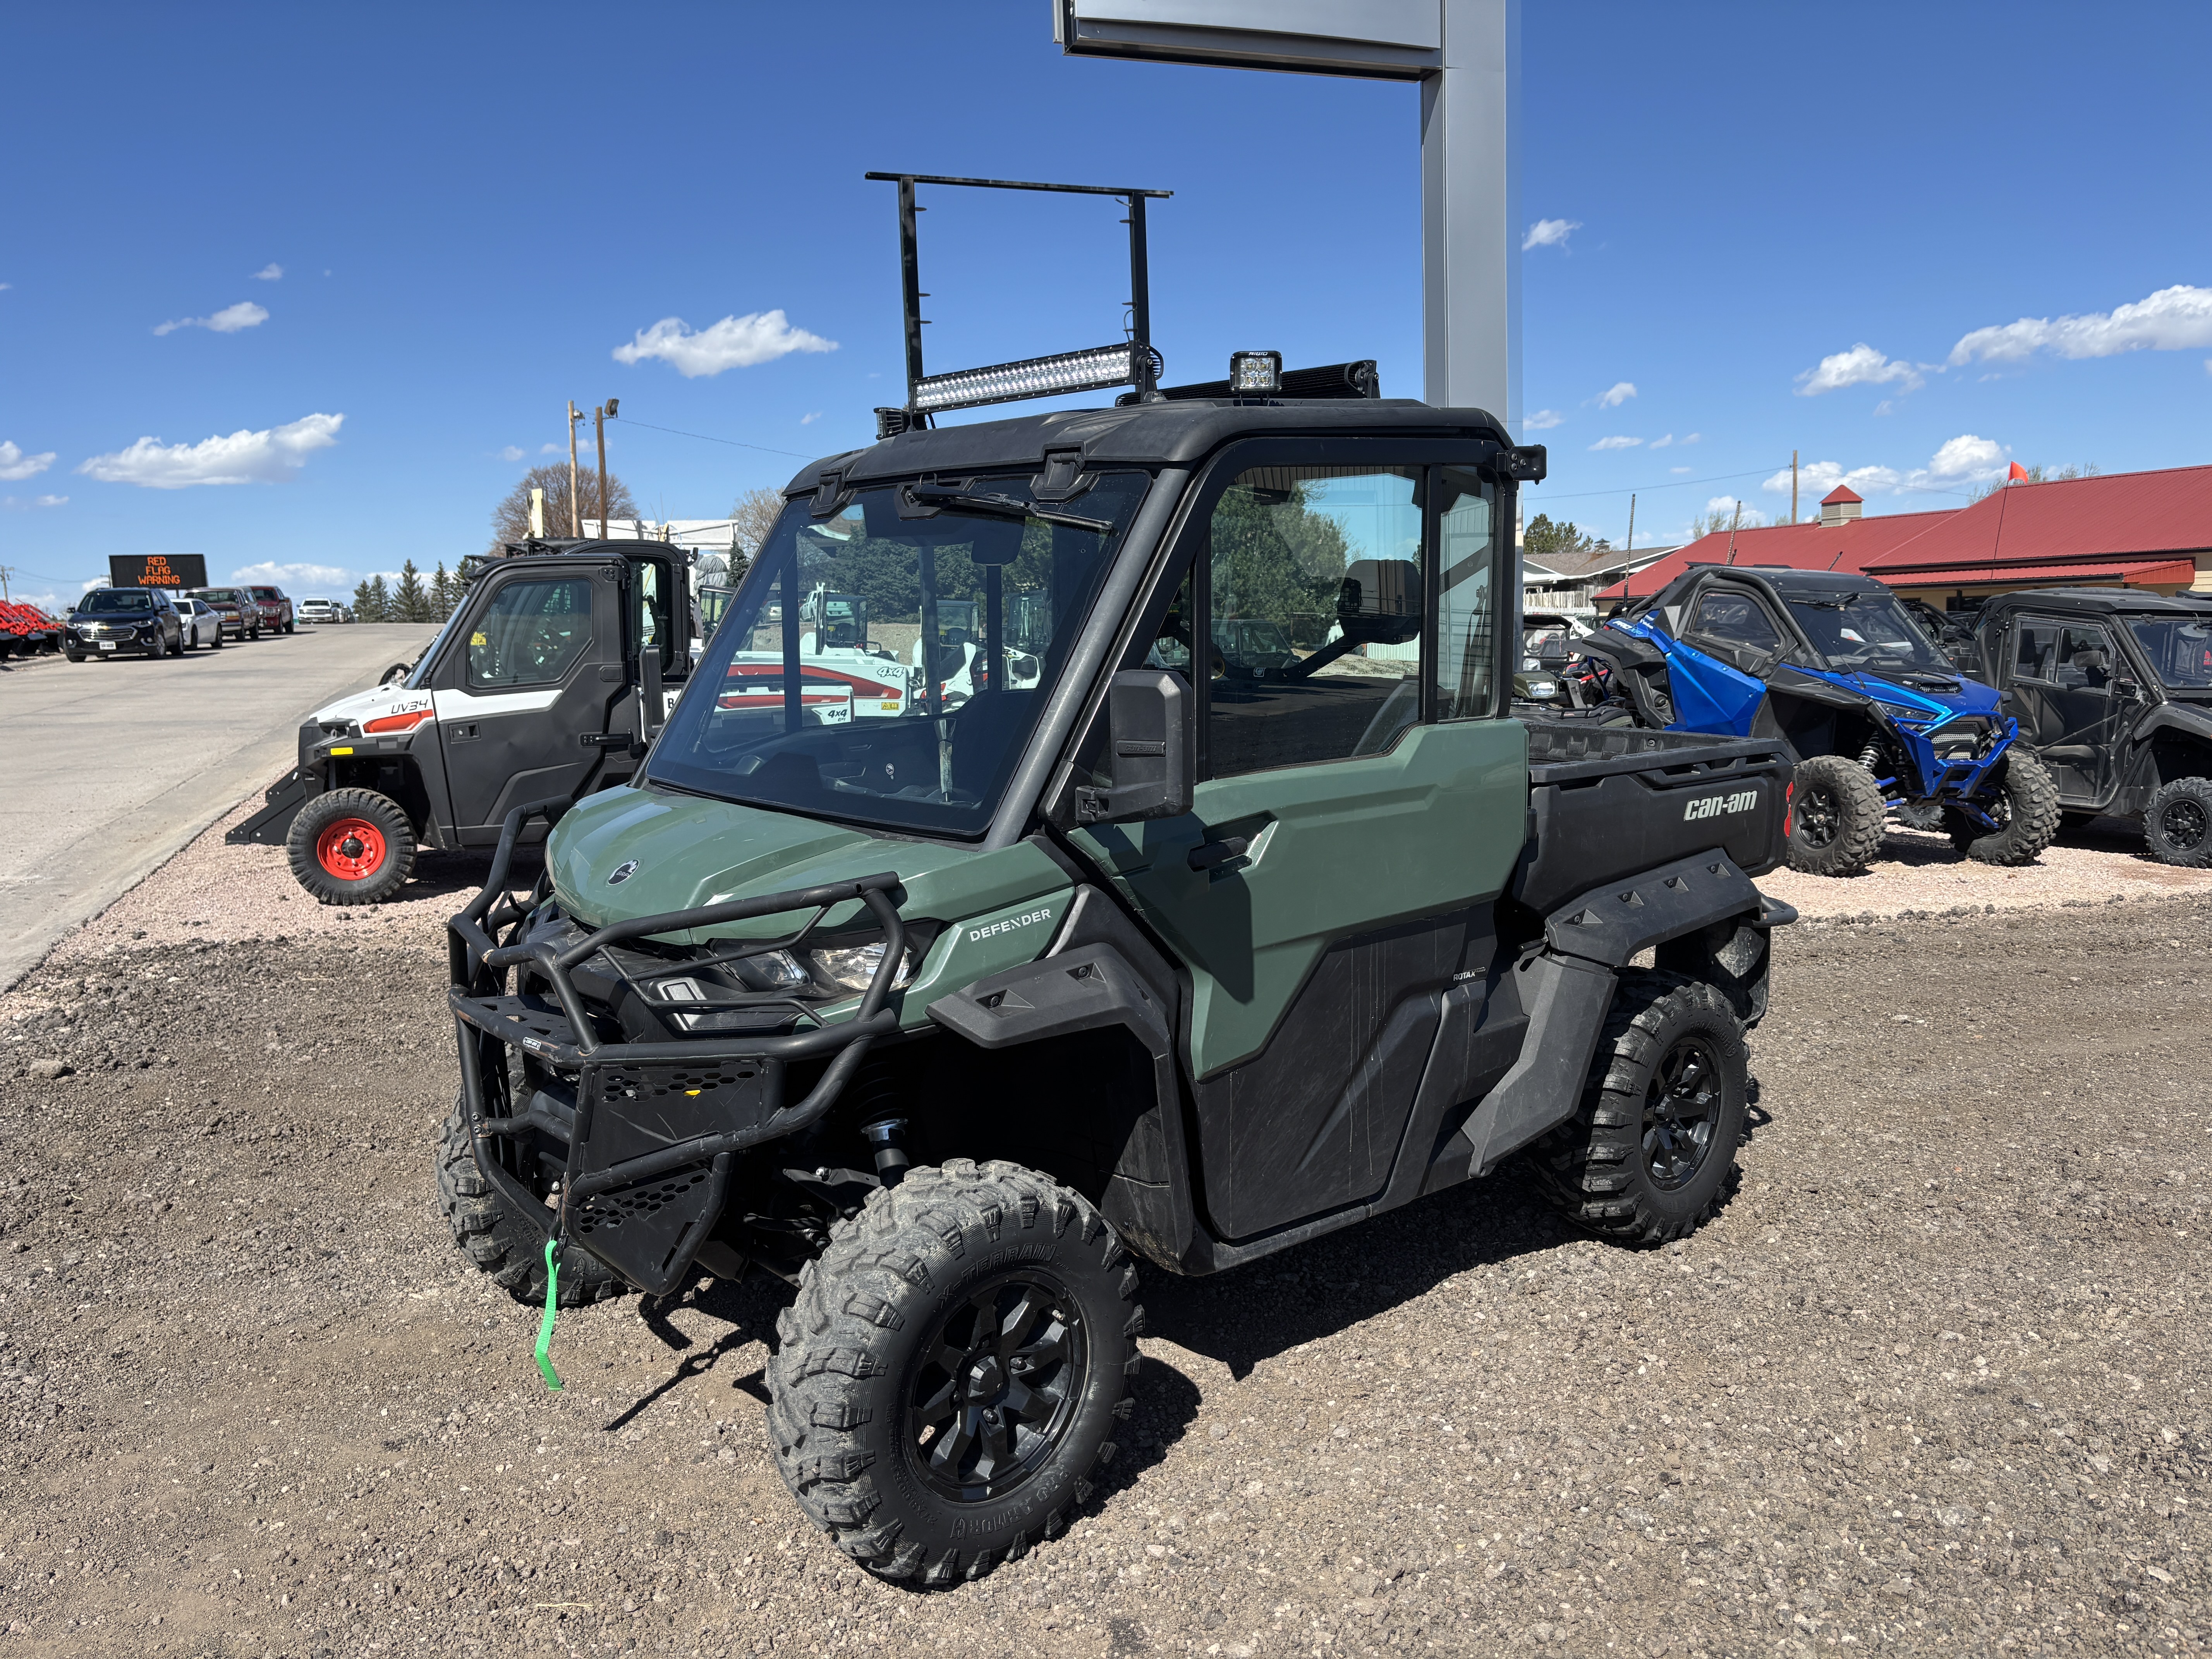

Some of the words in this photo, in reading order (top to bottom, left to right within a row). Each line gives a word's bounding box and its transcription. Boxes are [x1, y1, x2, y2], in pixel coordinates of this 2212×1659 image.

[147, 556, 167, 566] RED
[146, 565, 171, 575] FLAG
[137, 575, 180, 585] WARNING
[1613, 620, 1633, 629] PRO
[391, 699, 428, 714] UV34
[1685, 790, 1757, 821] can-am
[969, 908, 1052, 941] DEFENDER
[1453, 971, 1476, 981] ROTAX
[936, 1243, 1057, 1309] X-TERRAIN
